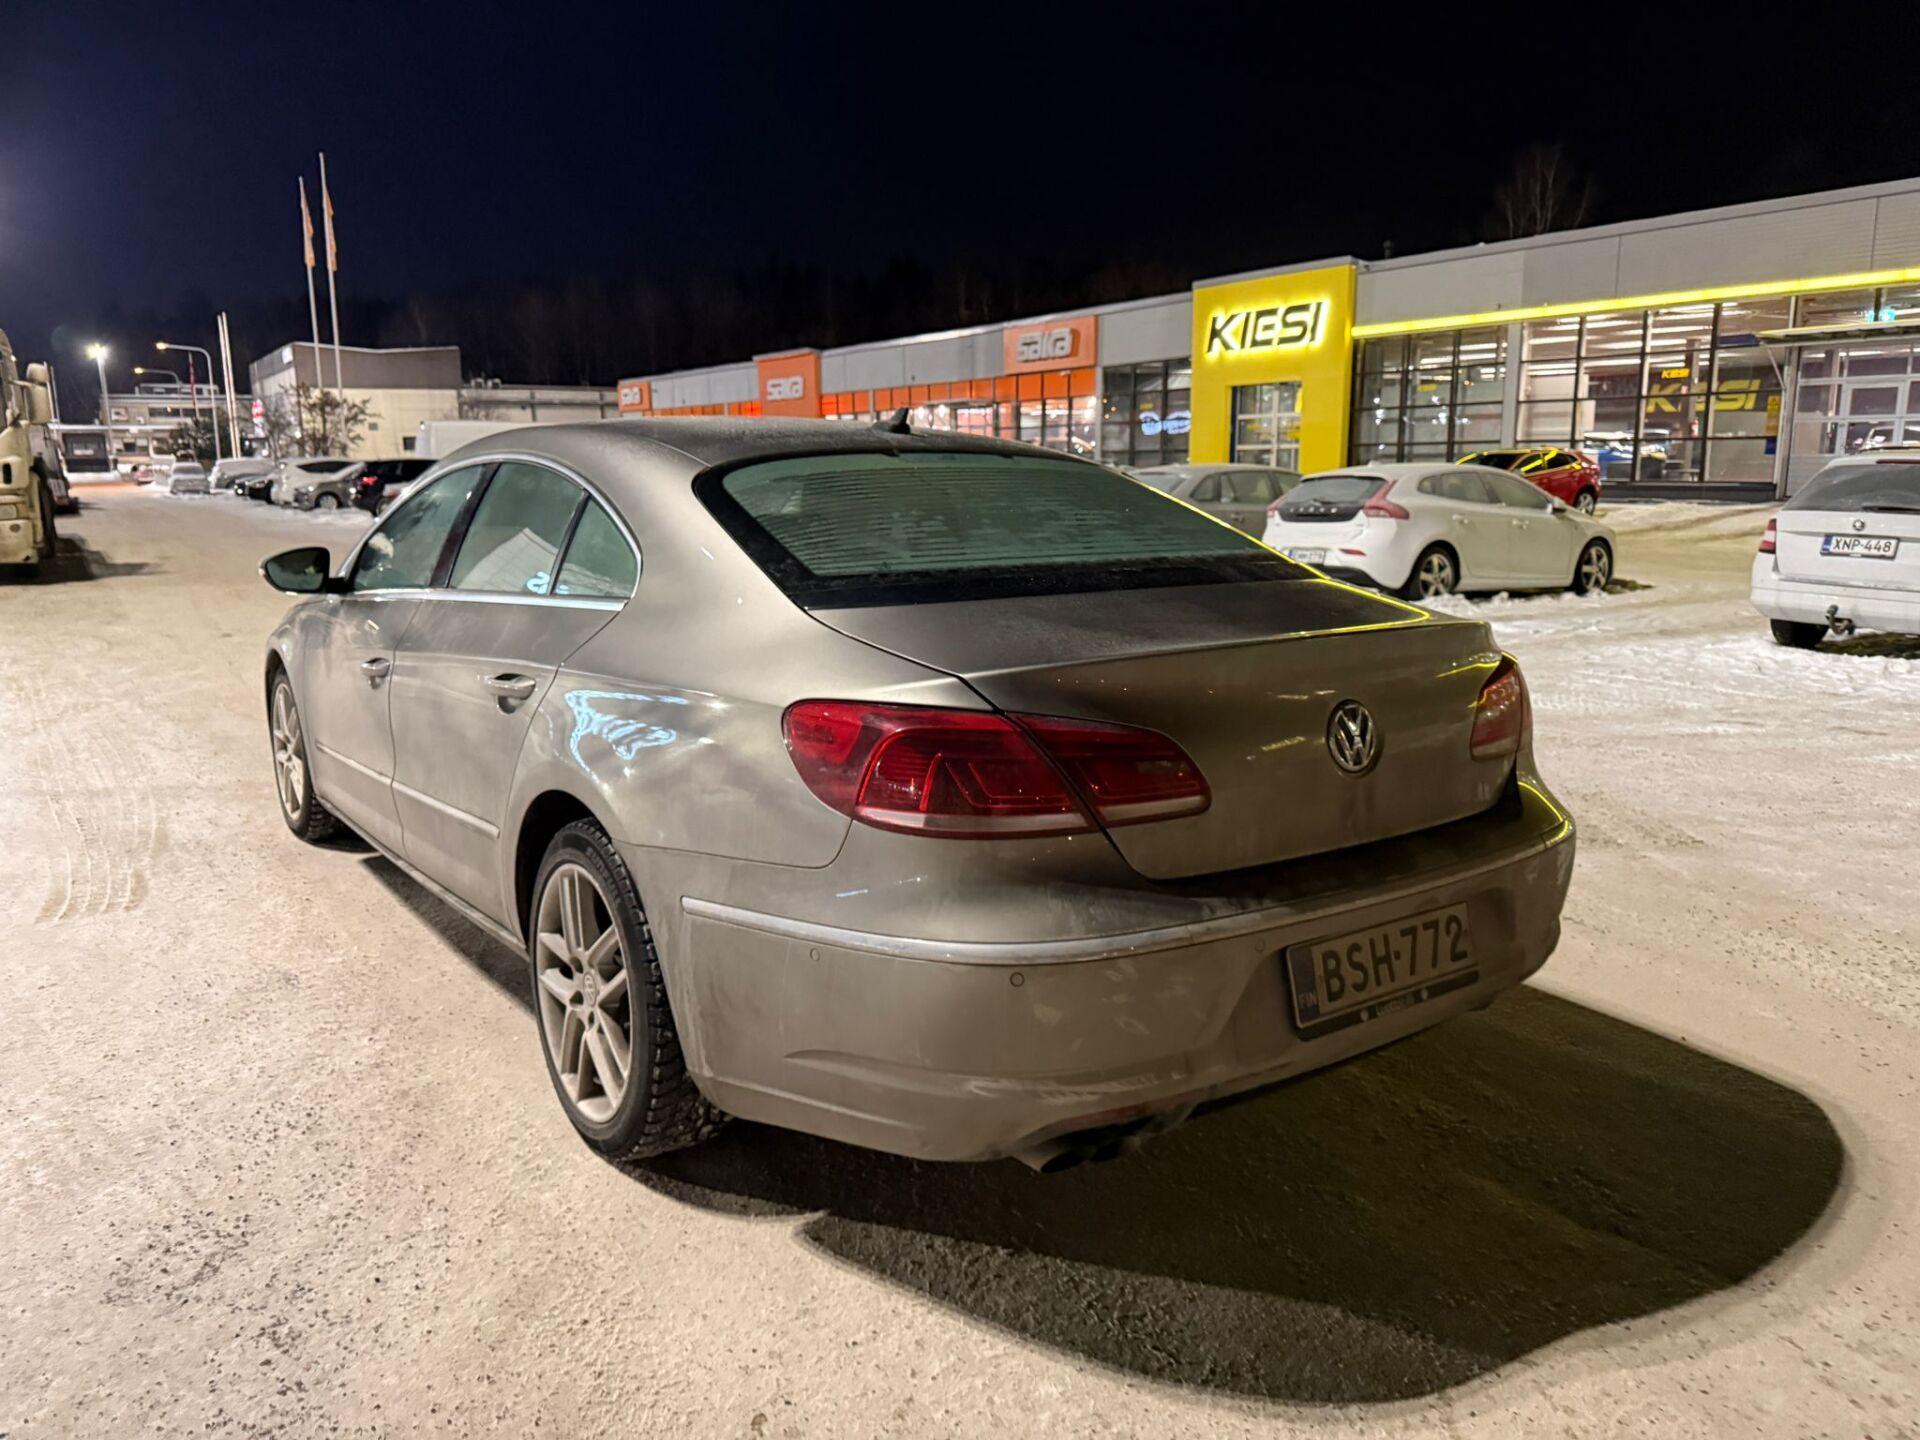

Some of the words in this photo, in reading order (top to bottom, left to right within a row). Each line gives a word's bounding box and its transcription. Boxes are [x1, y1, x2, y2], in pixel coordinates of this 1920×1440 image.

[1206, 301, 1323, 354] KIESI
[1833, 538, 1892, 553] XNP-448
[1322, 914, 1469, 1003] BSH-772
